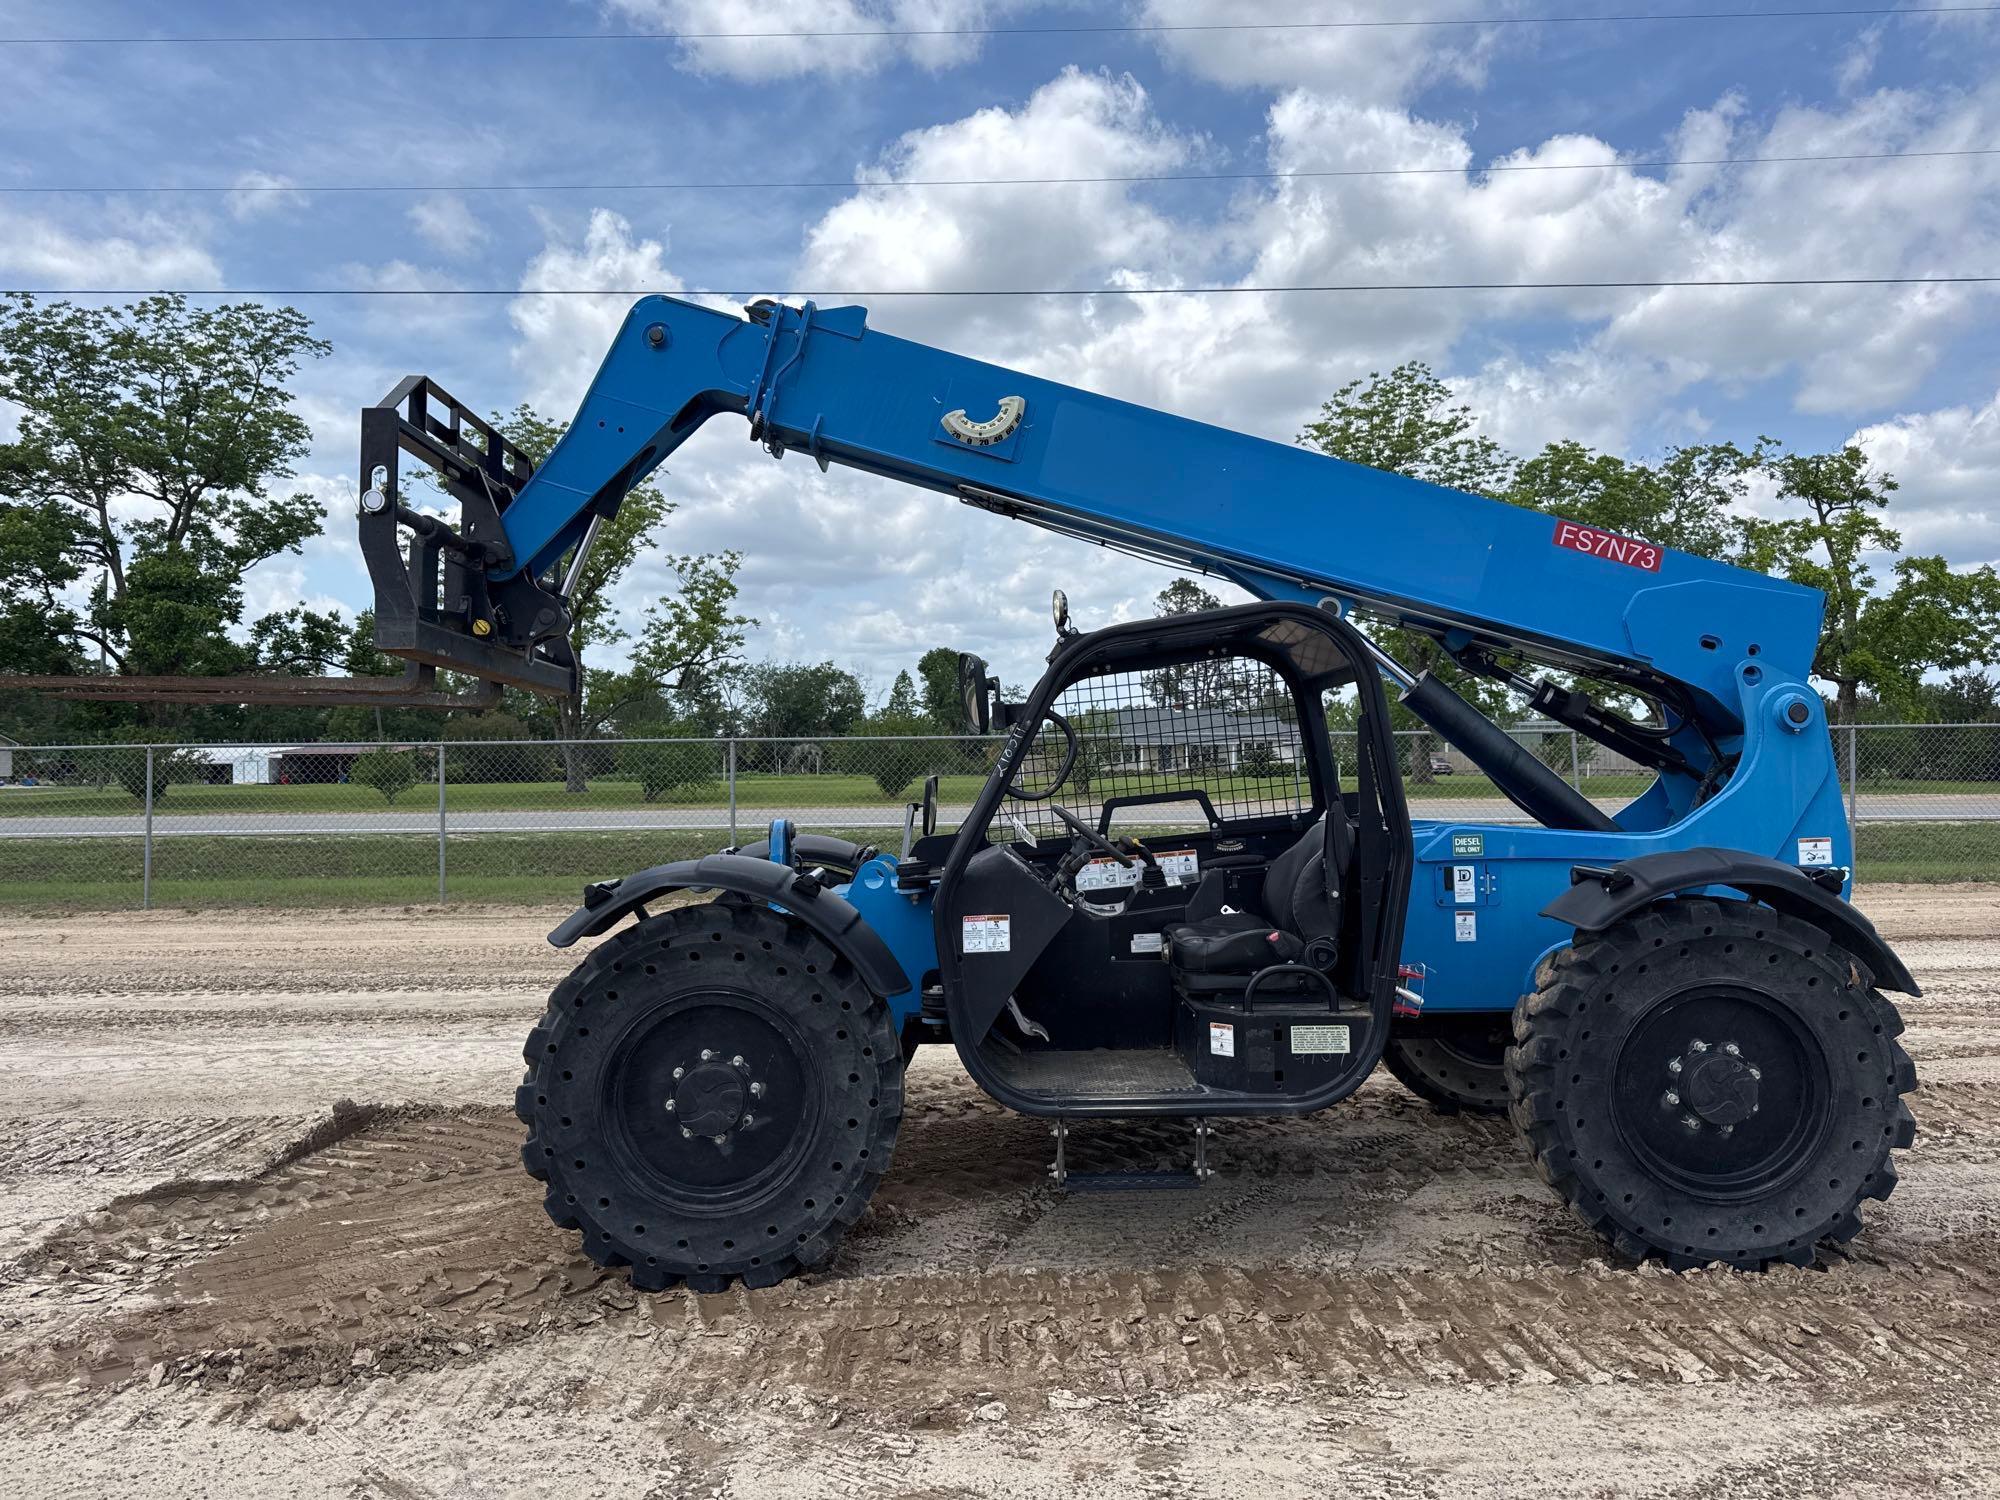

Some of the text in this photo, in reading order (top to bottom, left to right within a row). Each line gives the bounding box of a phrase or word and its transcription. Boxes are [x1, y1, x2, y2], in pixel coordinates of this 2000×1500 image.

[967, 437, 973, 445] 0
[1006, 425, 1015, 435] 60
[1015, 413, 1022, 424] 80
[1559, 525, 1656, 569] FS7N73
[1454, 838, 1481, 846] DIESEL
